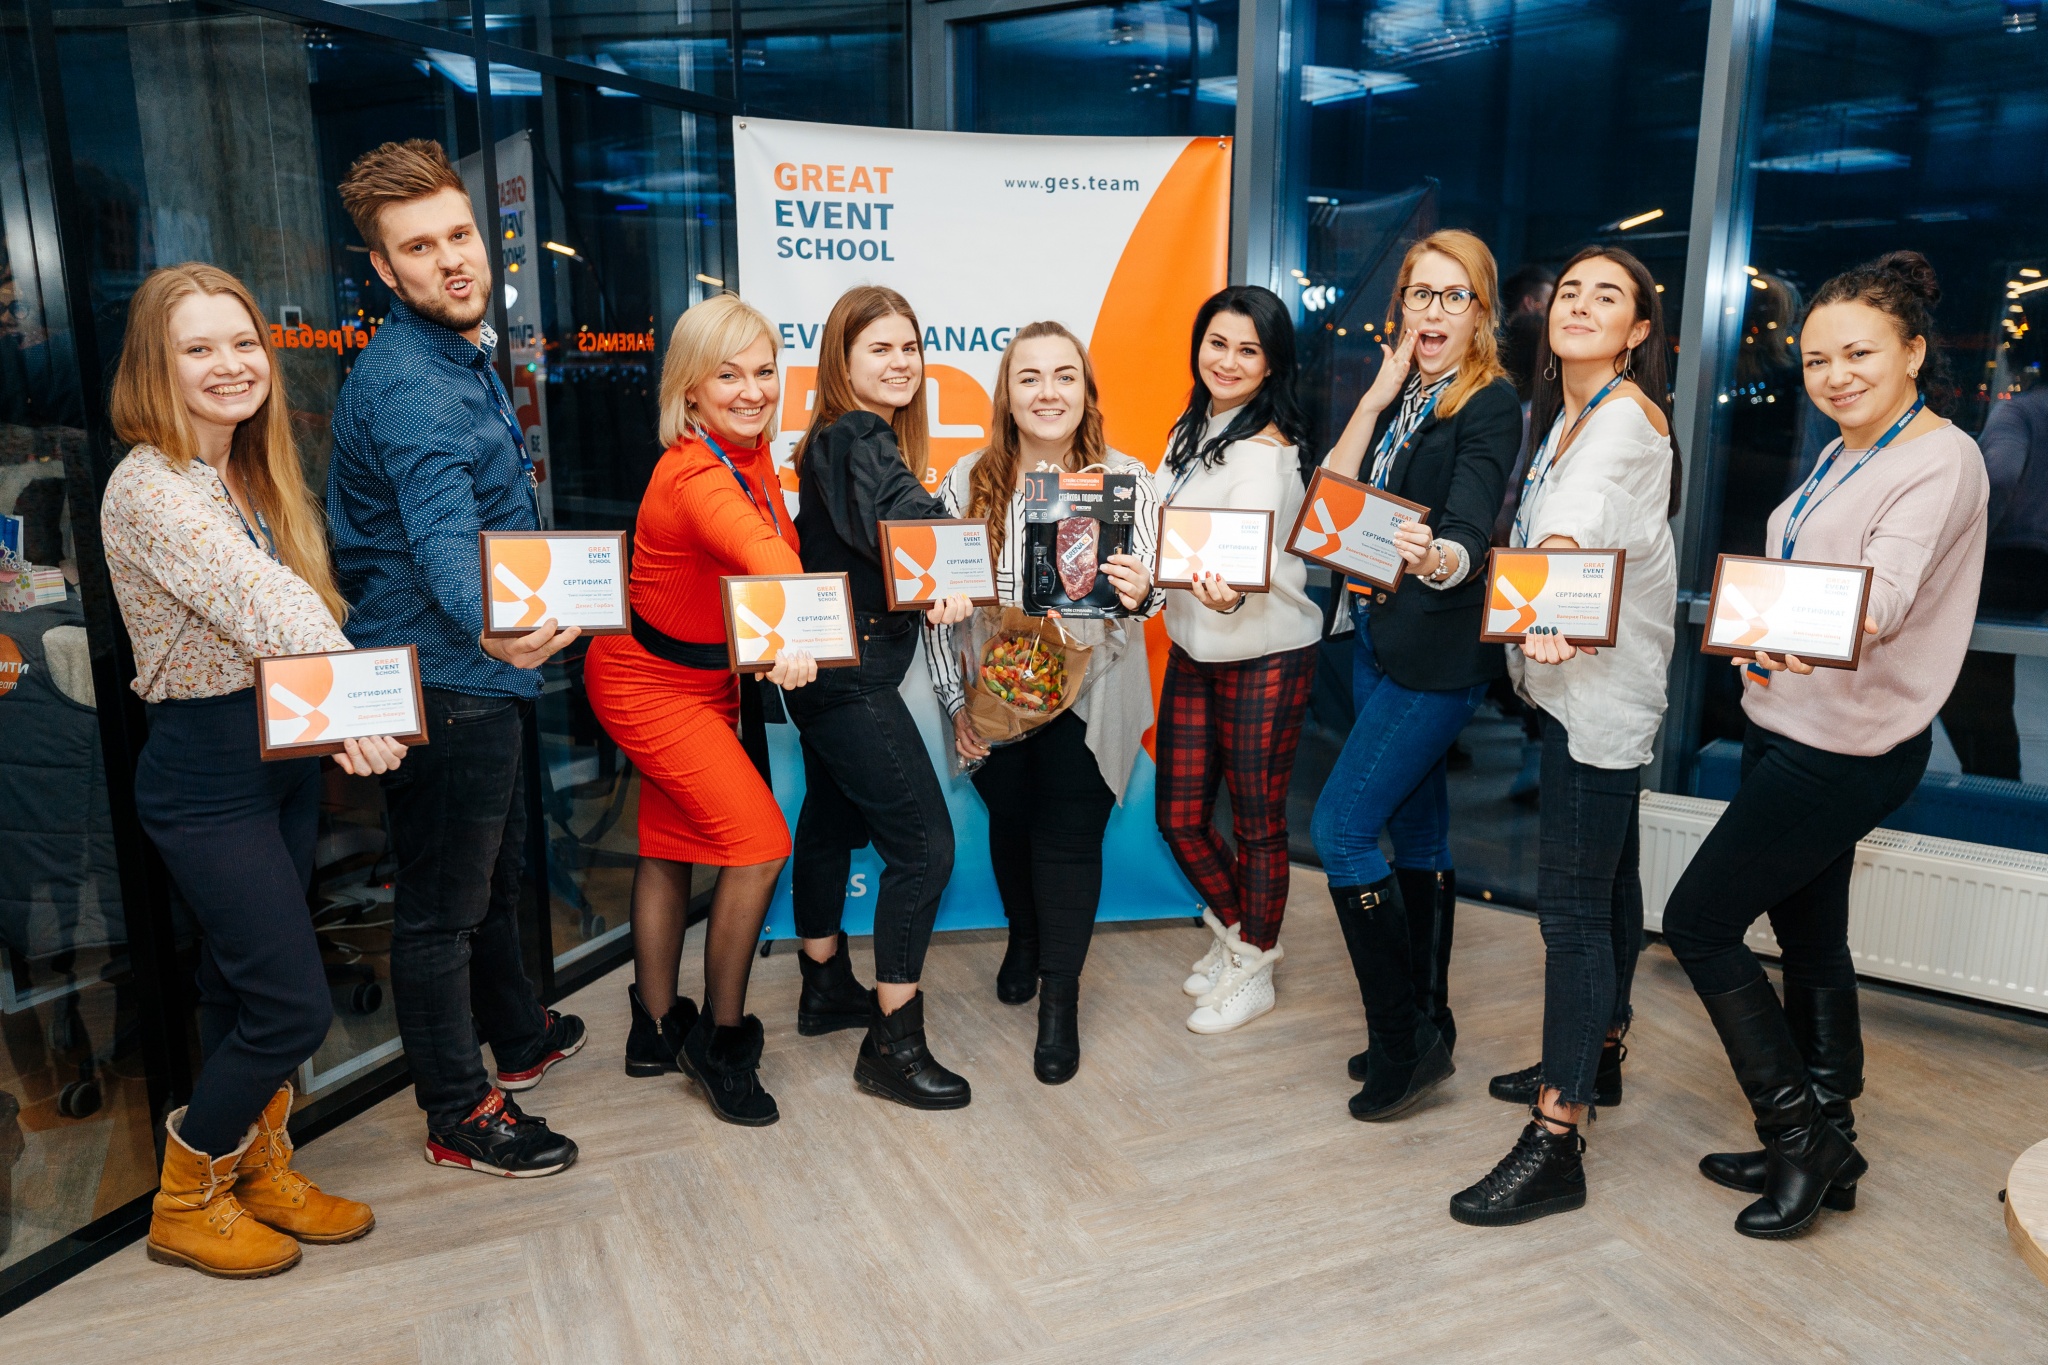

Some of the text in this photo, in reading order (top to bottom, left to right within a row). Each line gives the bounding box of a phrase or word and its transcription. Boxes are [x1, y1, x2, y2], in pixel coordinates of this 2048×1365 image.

[774, 162, 893, 194] GREAT
[1004, 176, 1139, 193] www.ges.team
[775, 199, 894, 230] EVENT
[776, 236, 895, 261] SCHOOL
[923, 326, 1021, 352] ANAG
[1025, 478, 1048, 502] 01
[1394, 512, 1412, 521] GREAT
[0, 681, 18, 690] eam
[347, 688, 402, 698] СЕРТИФИКАТ
